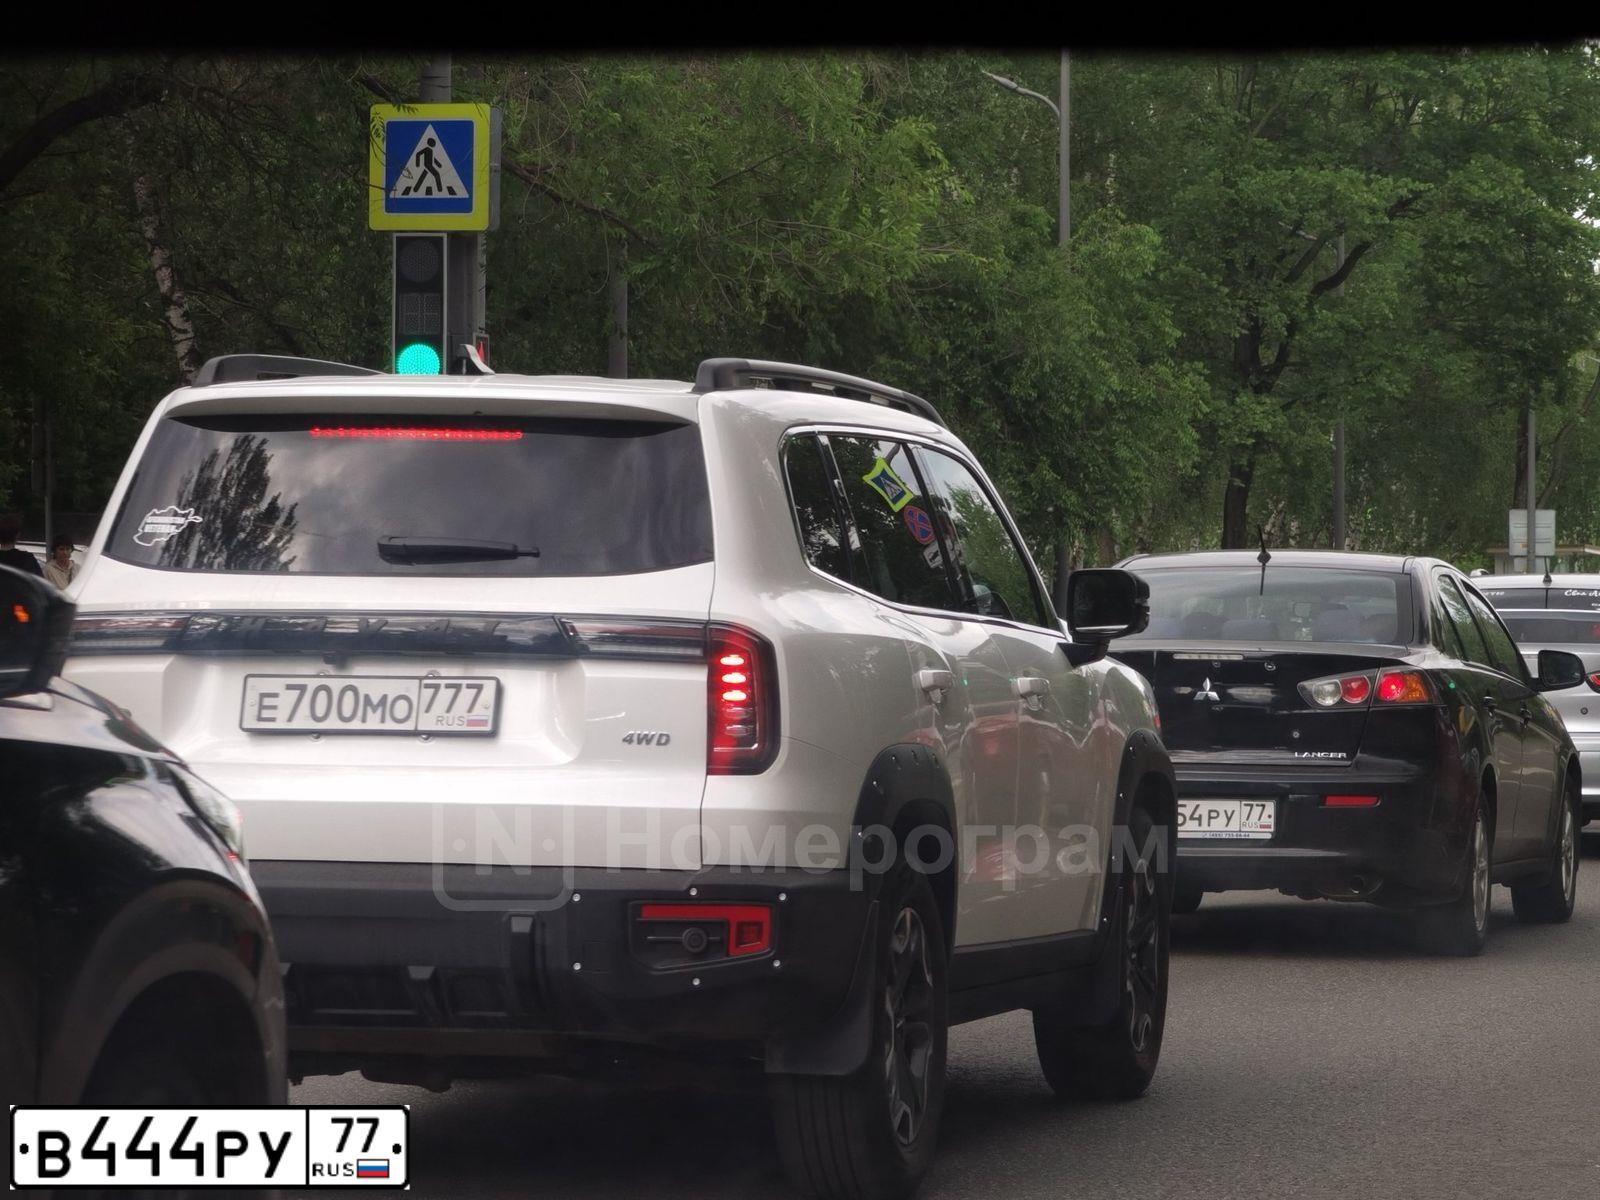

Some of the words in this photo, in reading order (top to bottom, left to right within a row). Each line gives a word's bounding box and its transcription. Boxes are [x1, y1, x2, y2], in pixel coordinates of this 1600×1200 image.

[255, 683, 414, 725] Е700МО
[422, 682, 485, 715] 777
[435, 715, 466, 727] RUS
[622, 731, 671, 746] 4WD
[1243, 803, 1267, 821] 77
[1242, 821, 1259, 829] RUS
